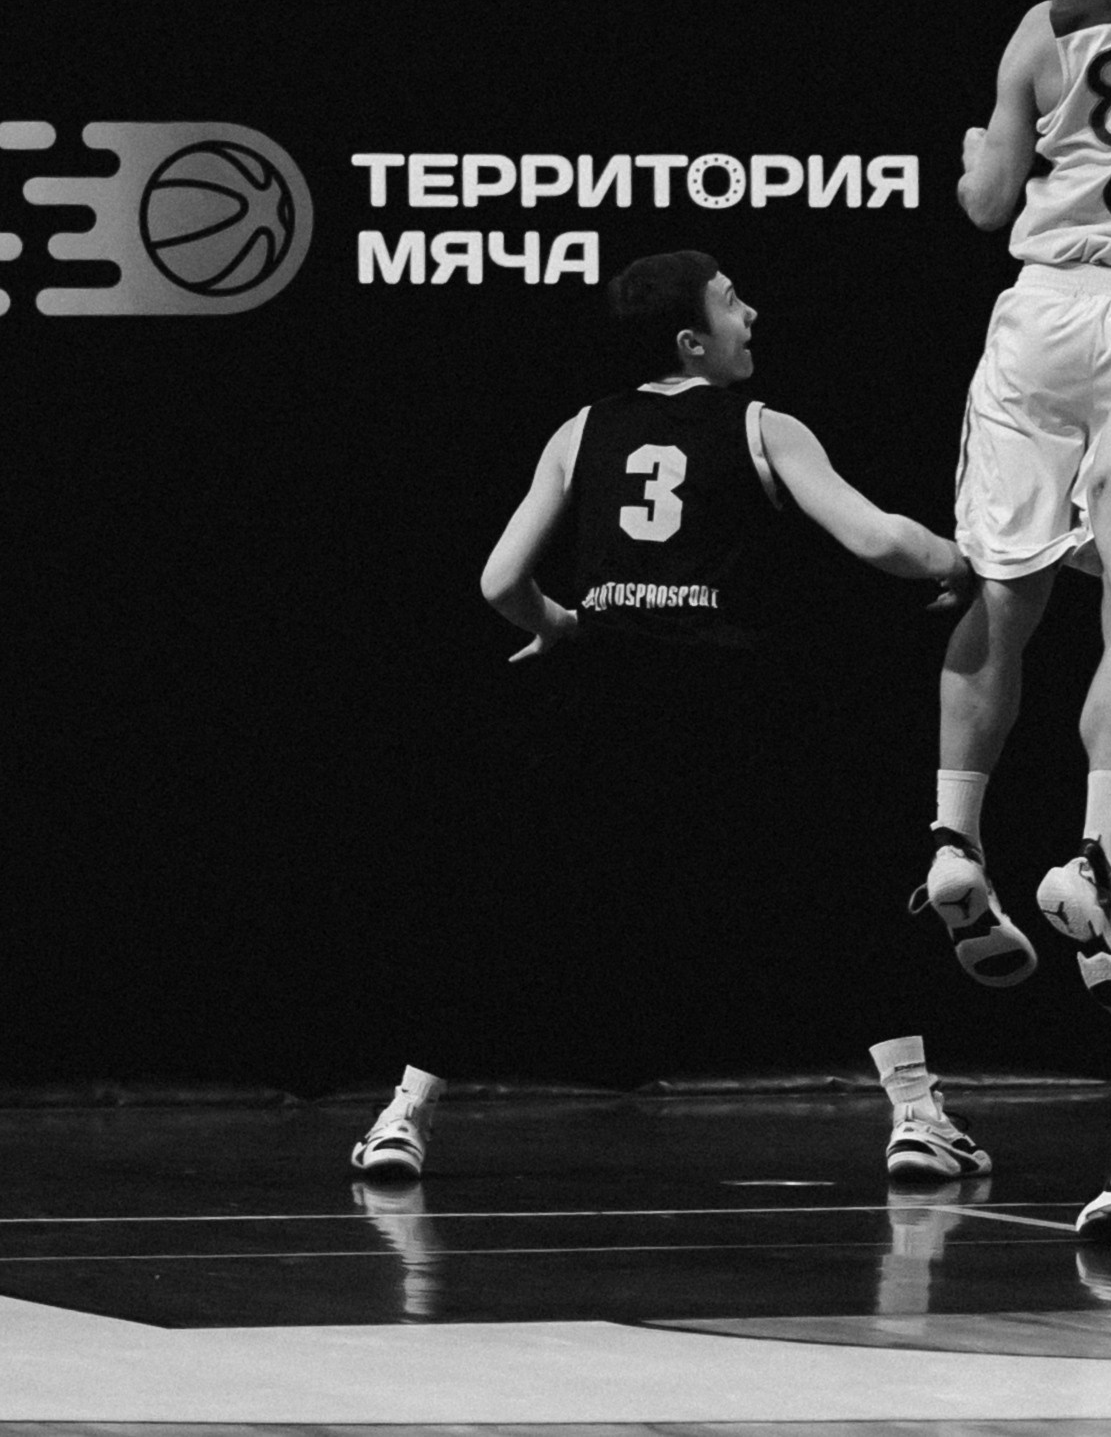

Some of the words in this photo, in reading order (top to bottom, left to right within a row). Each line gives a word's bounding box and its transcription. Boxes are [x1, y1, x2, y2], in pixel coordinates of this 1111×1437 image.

[351, 152, 920, 209] ТЕРРИТОРИЯ
[357, 230, 600, 285] МЯЧА
[619, 443, 688, 542] 3
